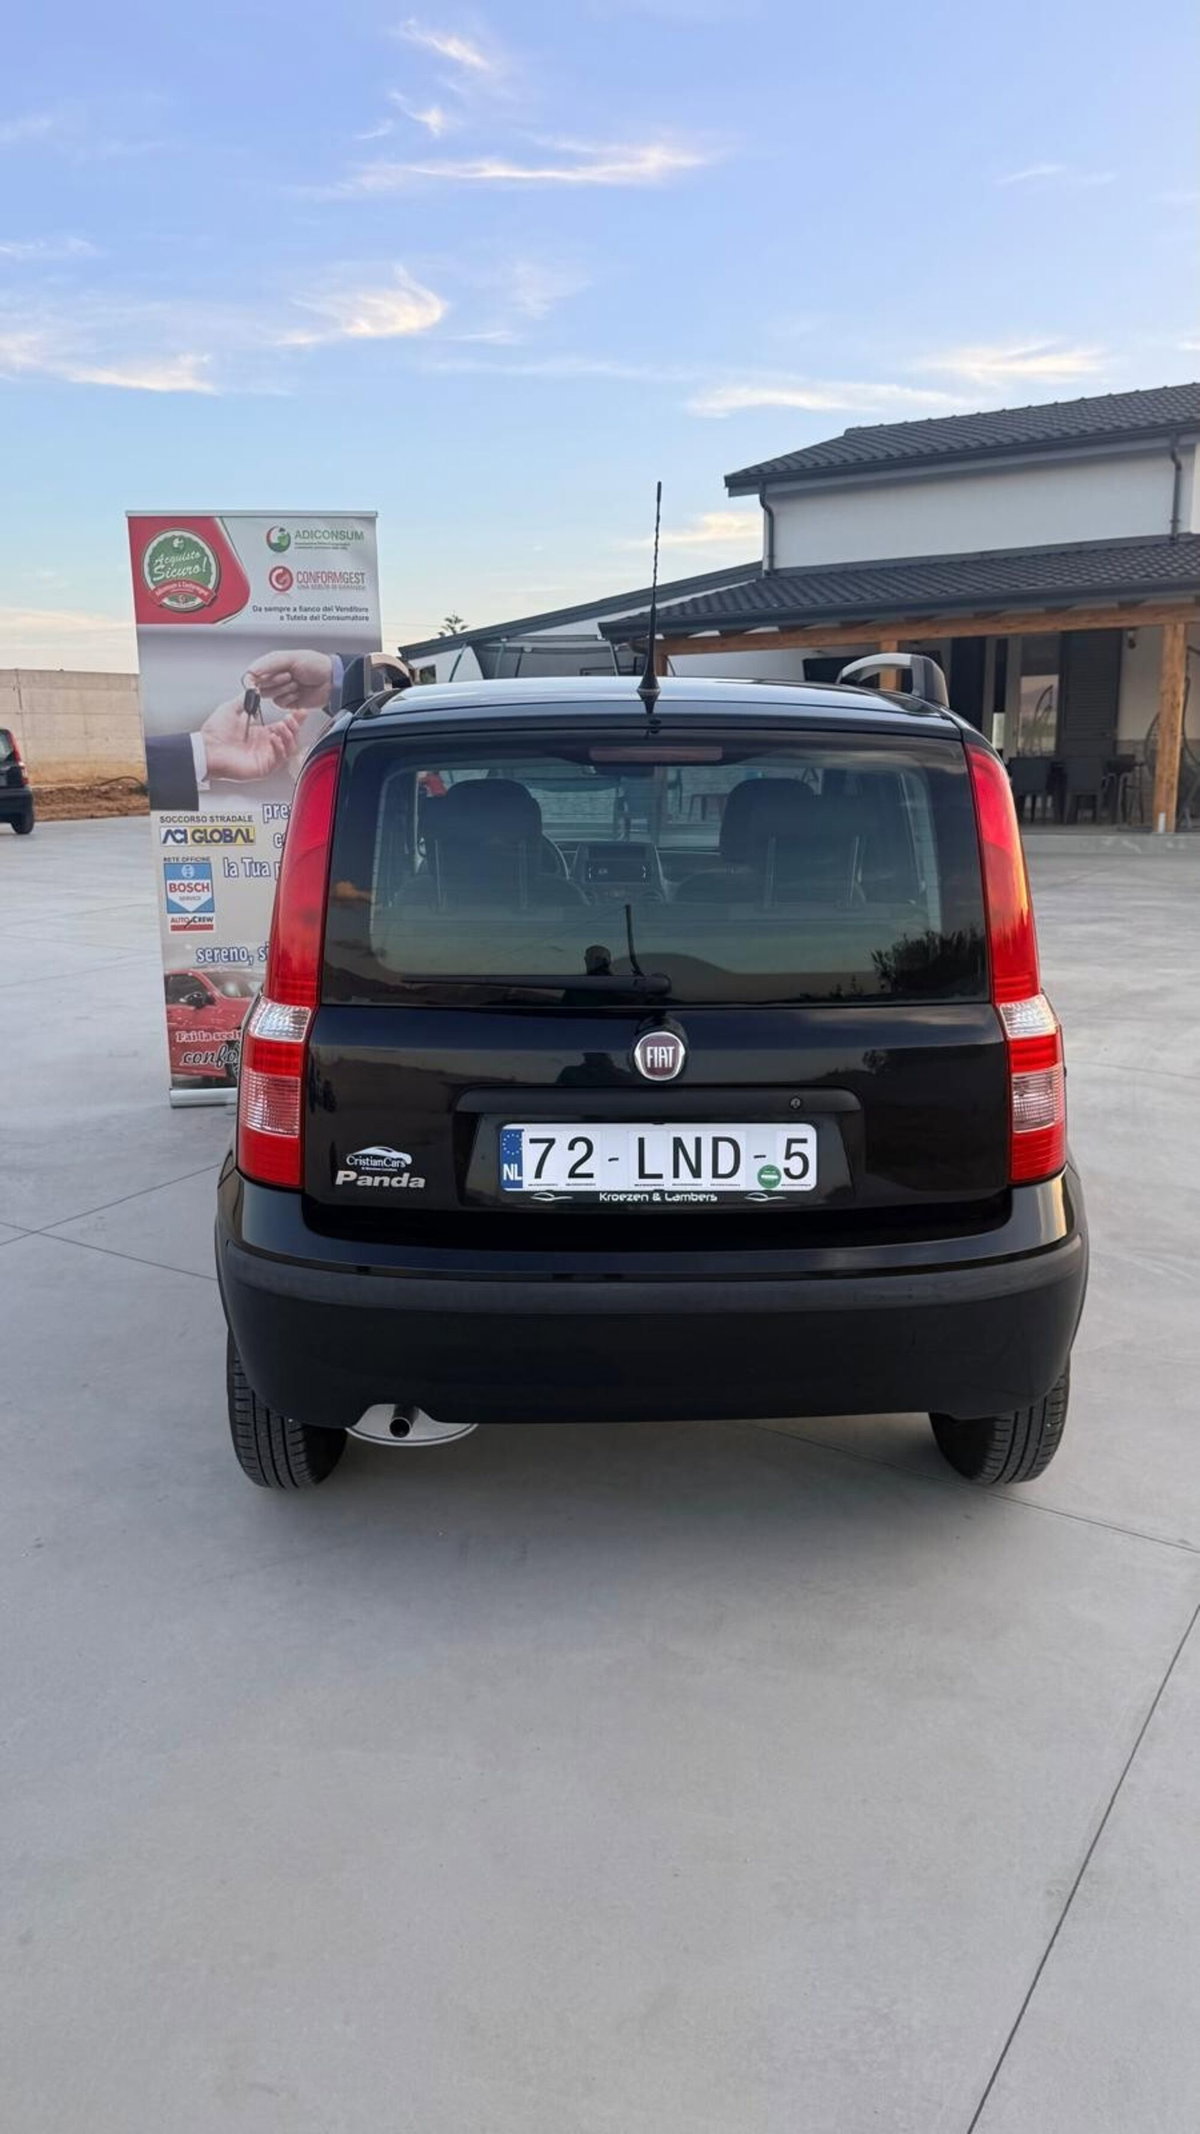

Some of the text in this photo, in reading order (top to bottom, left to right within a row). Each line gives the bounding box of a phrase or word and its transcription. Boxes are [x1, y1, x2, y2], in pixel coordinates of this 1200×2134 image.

[294, 530, 364, 541] ADICONSUM
[153, 551, 201, 567] Acquisto
[153, 557, 208, 581] Sicuro!
[296, 571, 366, 584] CONFORMGEST
[263, 804, 292, 823] pre
[162, 829, 254, 844] ACI GLOBAL
[223, 857, 239, 878] la
[242, 857, 271, 878] Tua
[168, 883, 210, 893] BOSCH
[196, 947, 254, 966] sereno,
[646, 1046, 675, 1069] FIAT
[335, 1170, 426, 1188] Panda
[502, 1163, 523, 1181] NL
[599, 1192, 718, 1202] Kroezen & Lambers
